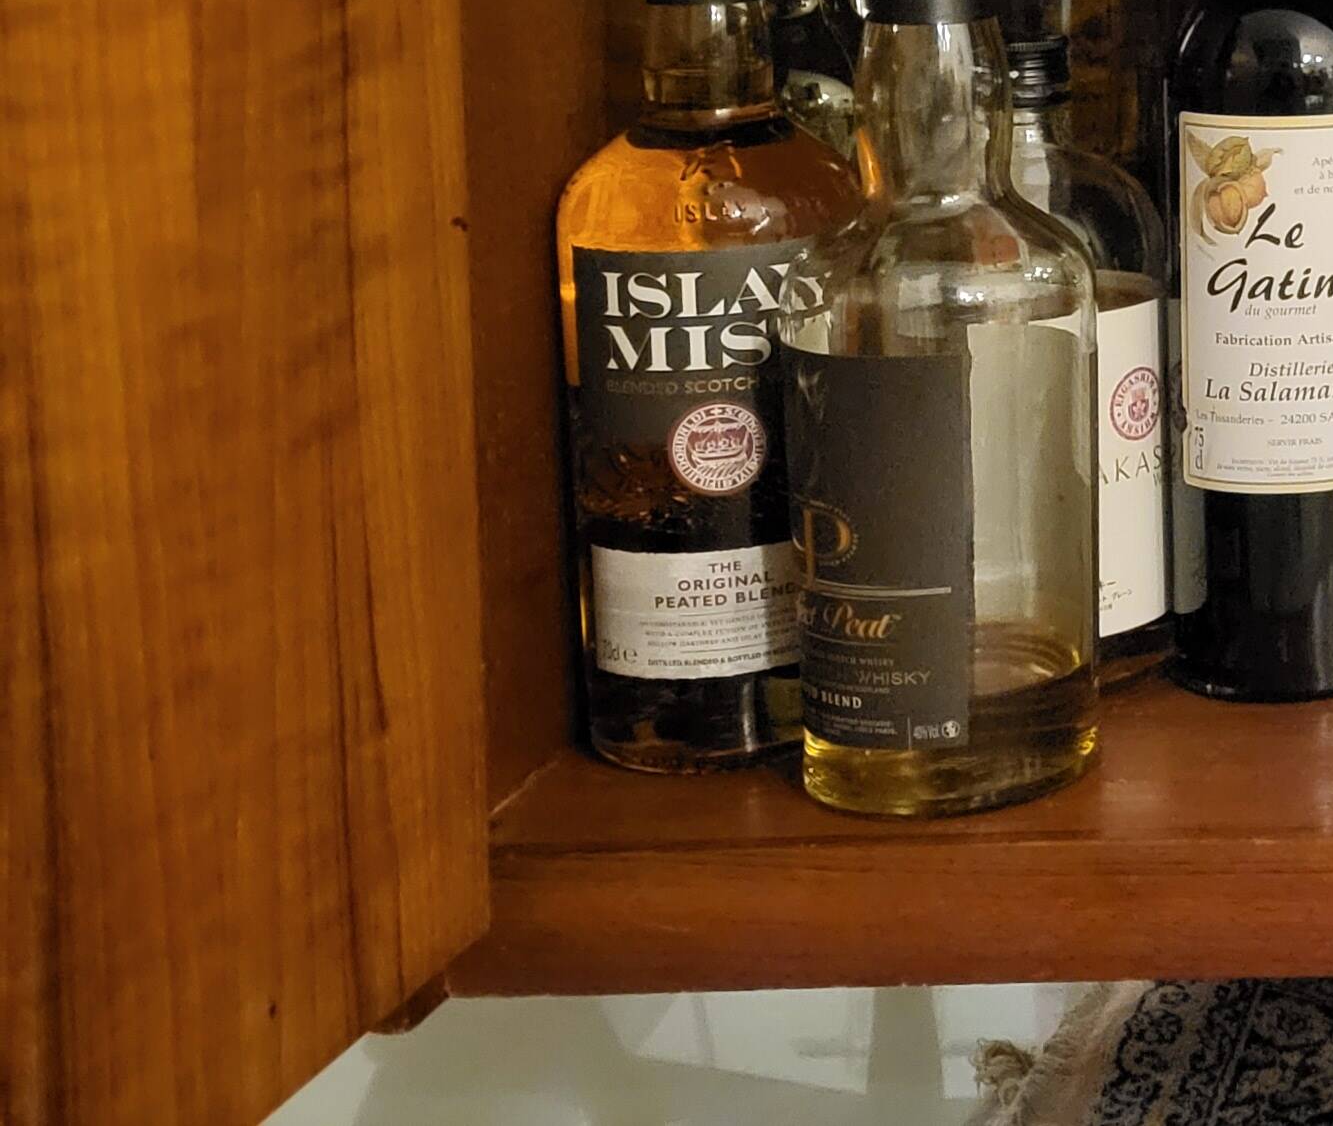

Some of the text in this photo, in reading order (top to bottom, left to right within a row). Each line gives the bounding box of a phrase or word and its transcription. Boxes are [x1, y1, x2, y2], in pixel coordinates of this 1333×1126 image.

[1307, 184, 1321, 195] de
[1244, 202, 1305, 250] Le
[601, 262, 830, 320] ISLAY
[1244, 303, 1317, 321] du gourmet
[603, 320, 772, 373] MIS
[1214, 331, 1293, 347] Fabrication
[606, 376, 760, 395] BLENDED SCOTCH
[1205, 378, 1231, 401] La
[1279, 413, 1317, 426] 24200
[1099, 444, 1164, 486] KAS
[708, 560, 742, 574] THE
[677, 570, 775, 592] ORIGINAL
[654, 582, 799, 609] PEATED BLEND
[856, 670, 932, 687] WHISKY
[820, 690, 863, 710] BLEND
